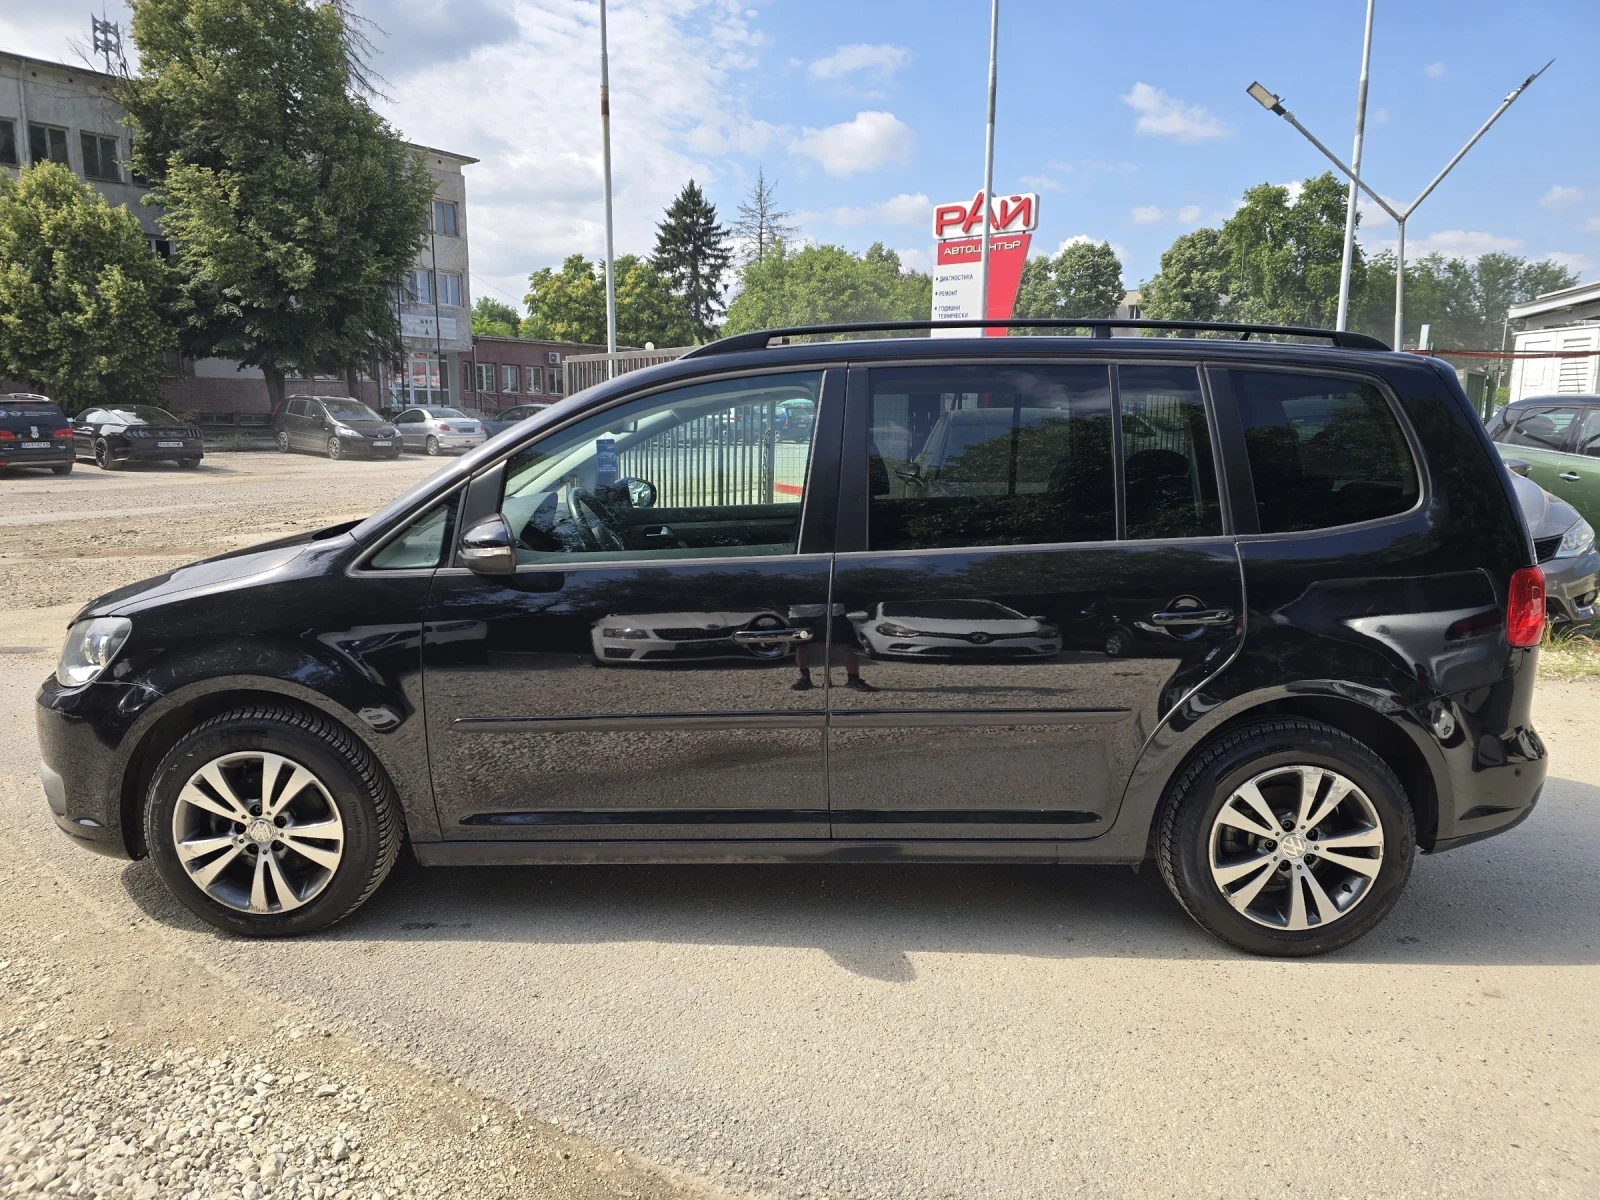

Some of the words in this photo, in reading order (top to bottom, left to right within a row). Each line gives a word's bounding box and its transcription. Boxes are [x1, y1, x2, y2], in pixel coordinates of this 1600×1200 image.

[936, 191, 1031, 236] РАЙ
[944, 241, 1021, 255] АВТОЦНТЪР
[939, 274, 974, 282] ДИАГНОСТИКА
